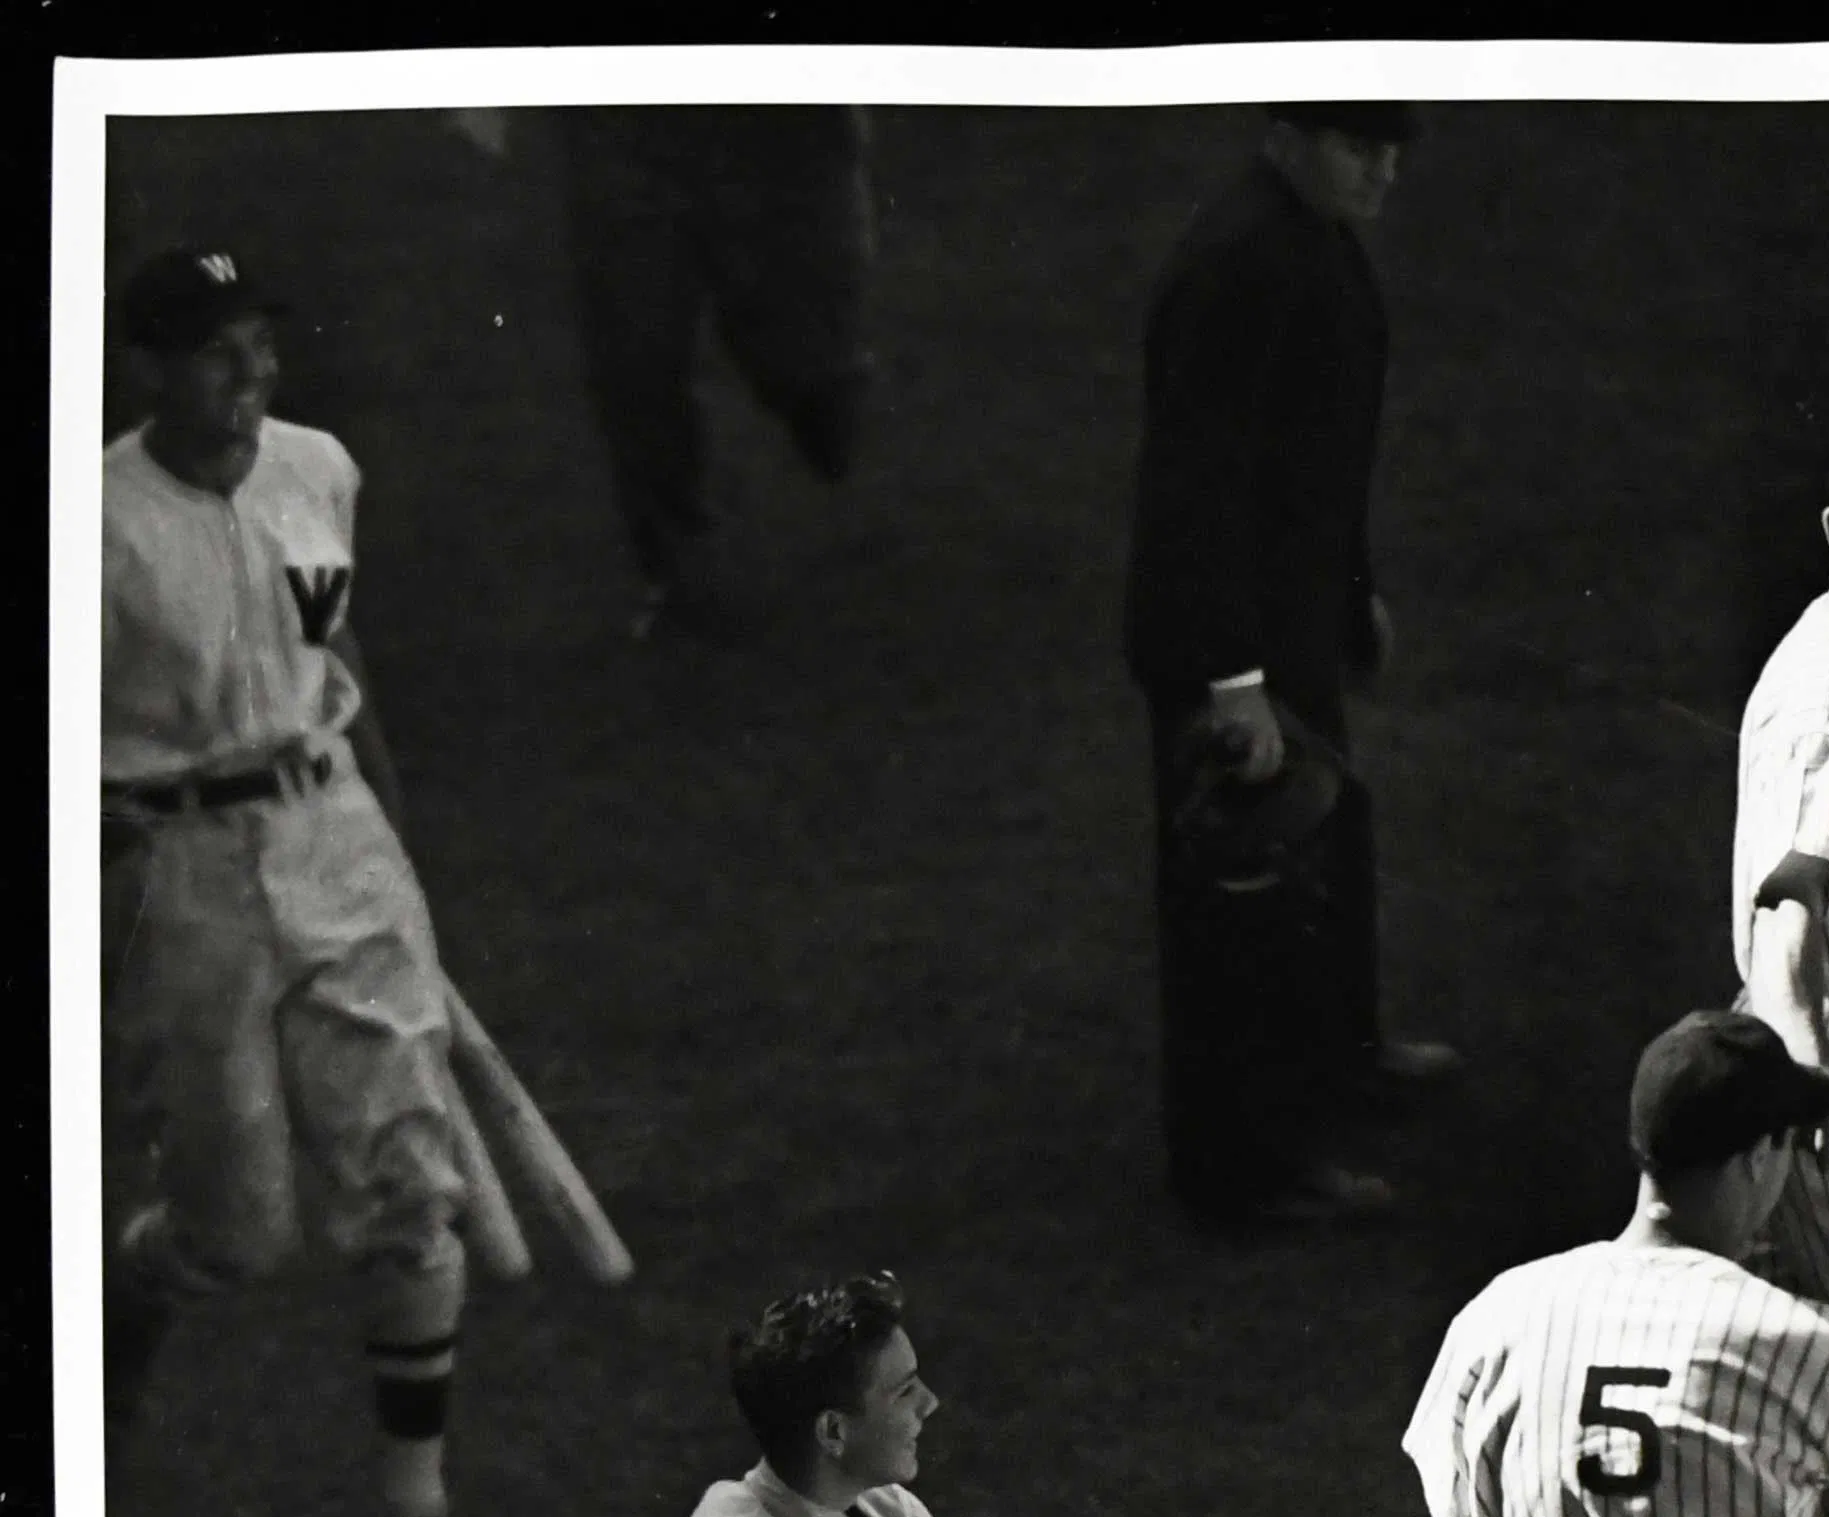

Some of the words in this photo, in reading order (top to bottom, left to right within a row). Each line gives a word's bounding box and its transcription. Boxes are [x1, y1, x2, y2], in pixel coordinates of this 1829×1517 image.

[201, 253, 237, 283] W
[285, 564, 347, 645] W
[1576, 1365, 1672, 1497] 5
